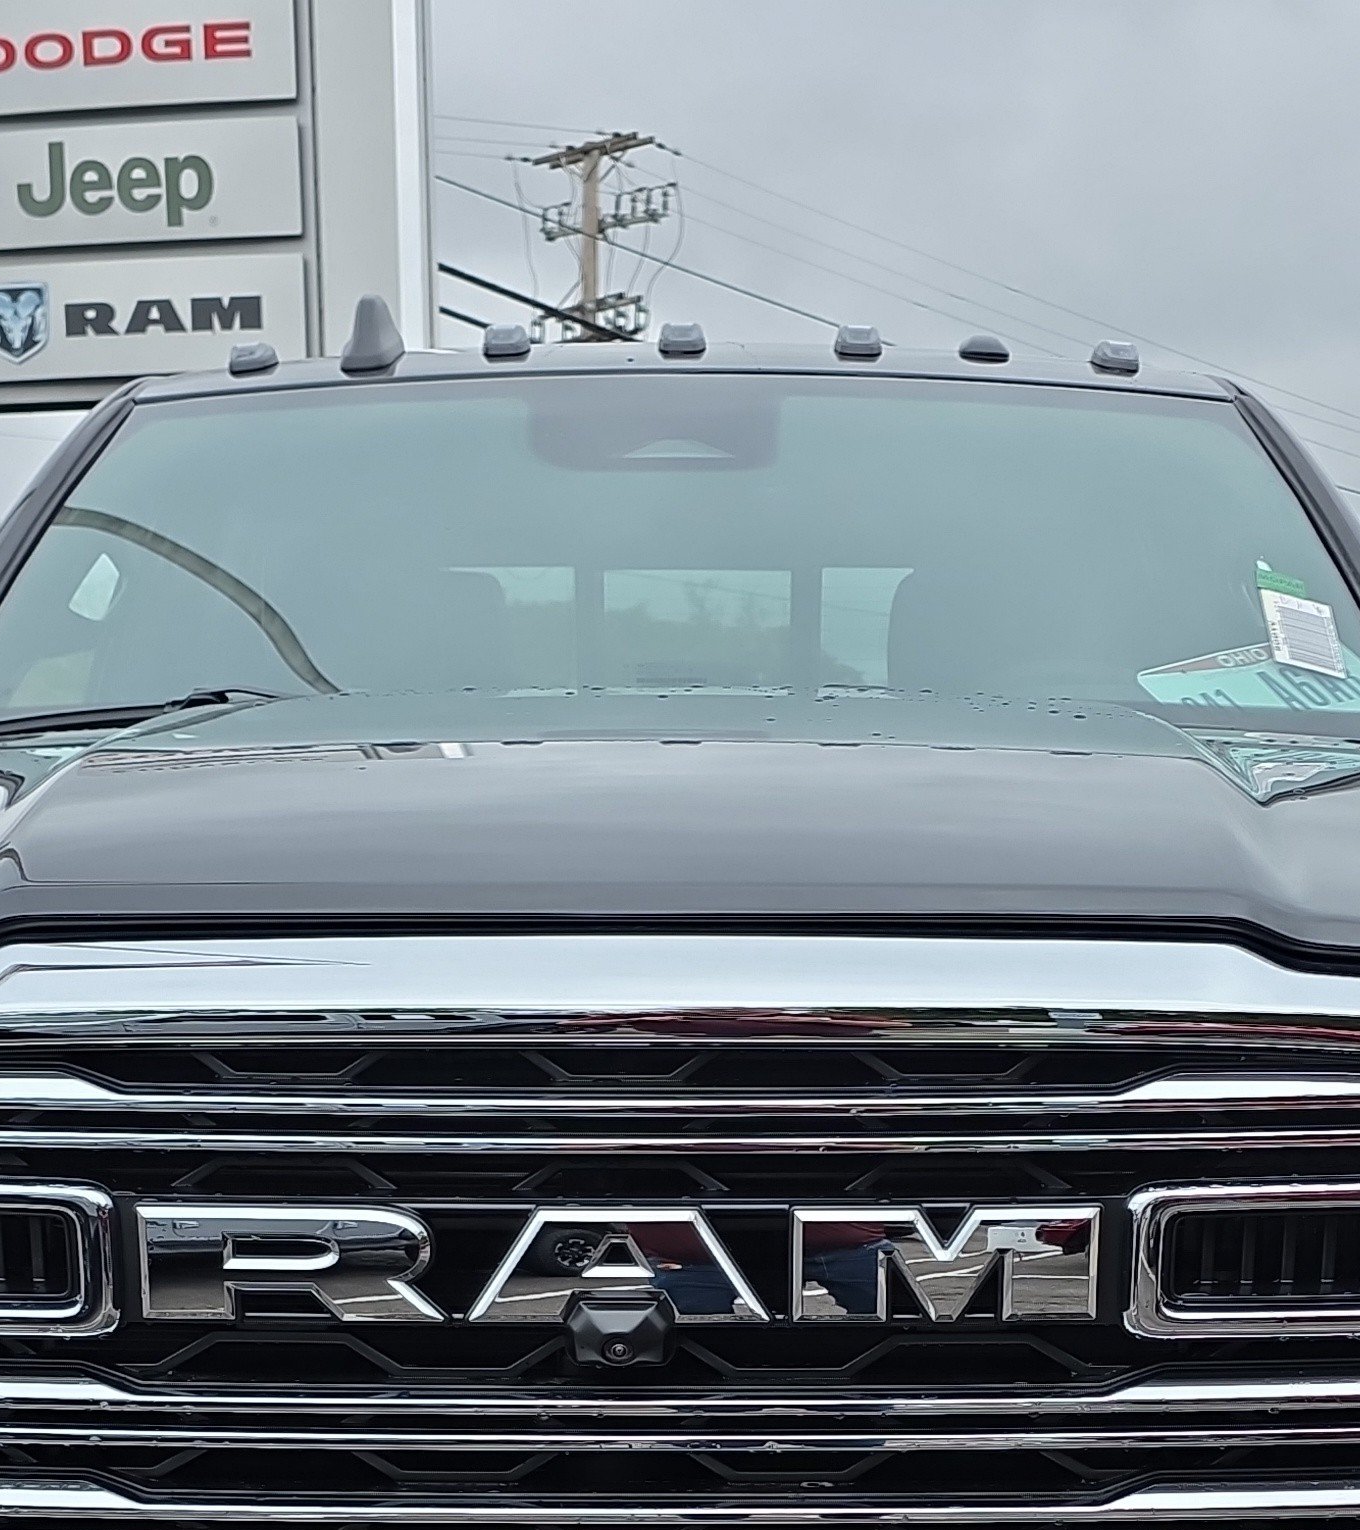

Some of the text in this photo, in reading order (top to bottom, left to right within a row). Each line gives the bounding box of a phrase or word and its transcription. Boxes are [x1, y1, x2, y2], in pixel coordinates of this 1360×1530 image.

[16, 141, 214, 227] Jeep
[64, 296, 262, 337] RAM
[1216, 648, 1269, 668] OHIO
[136, 1203, 1102, 1322] RAM
